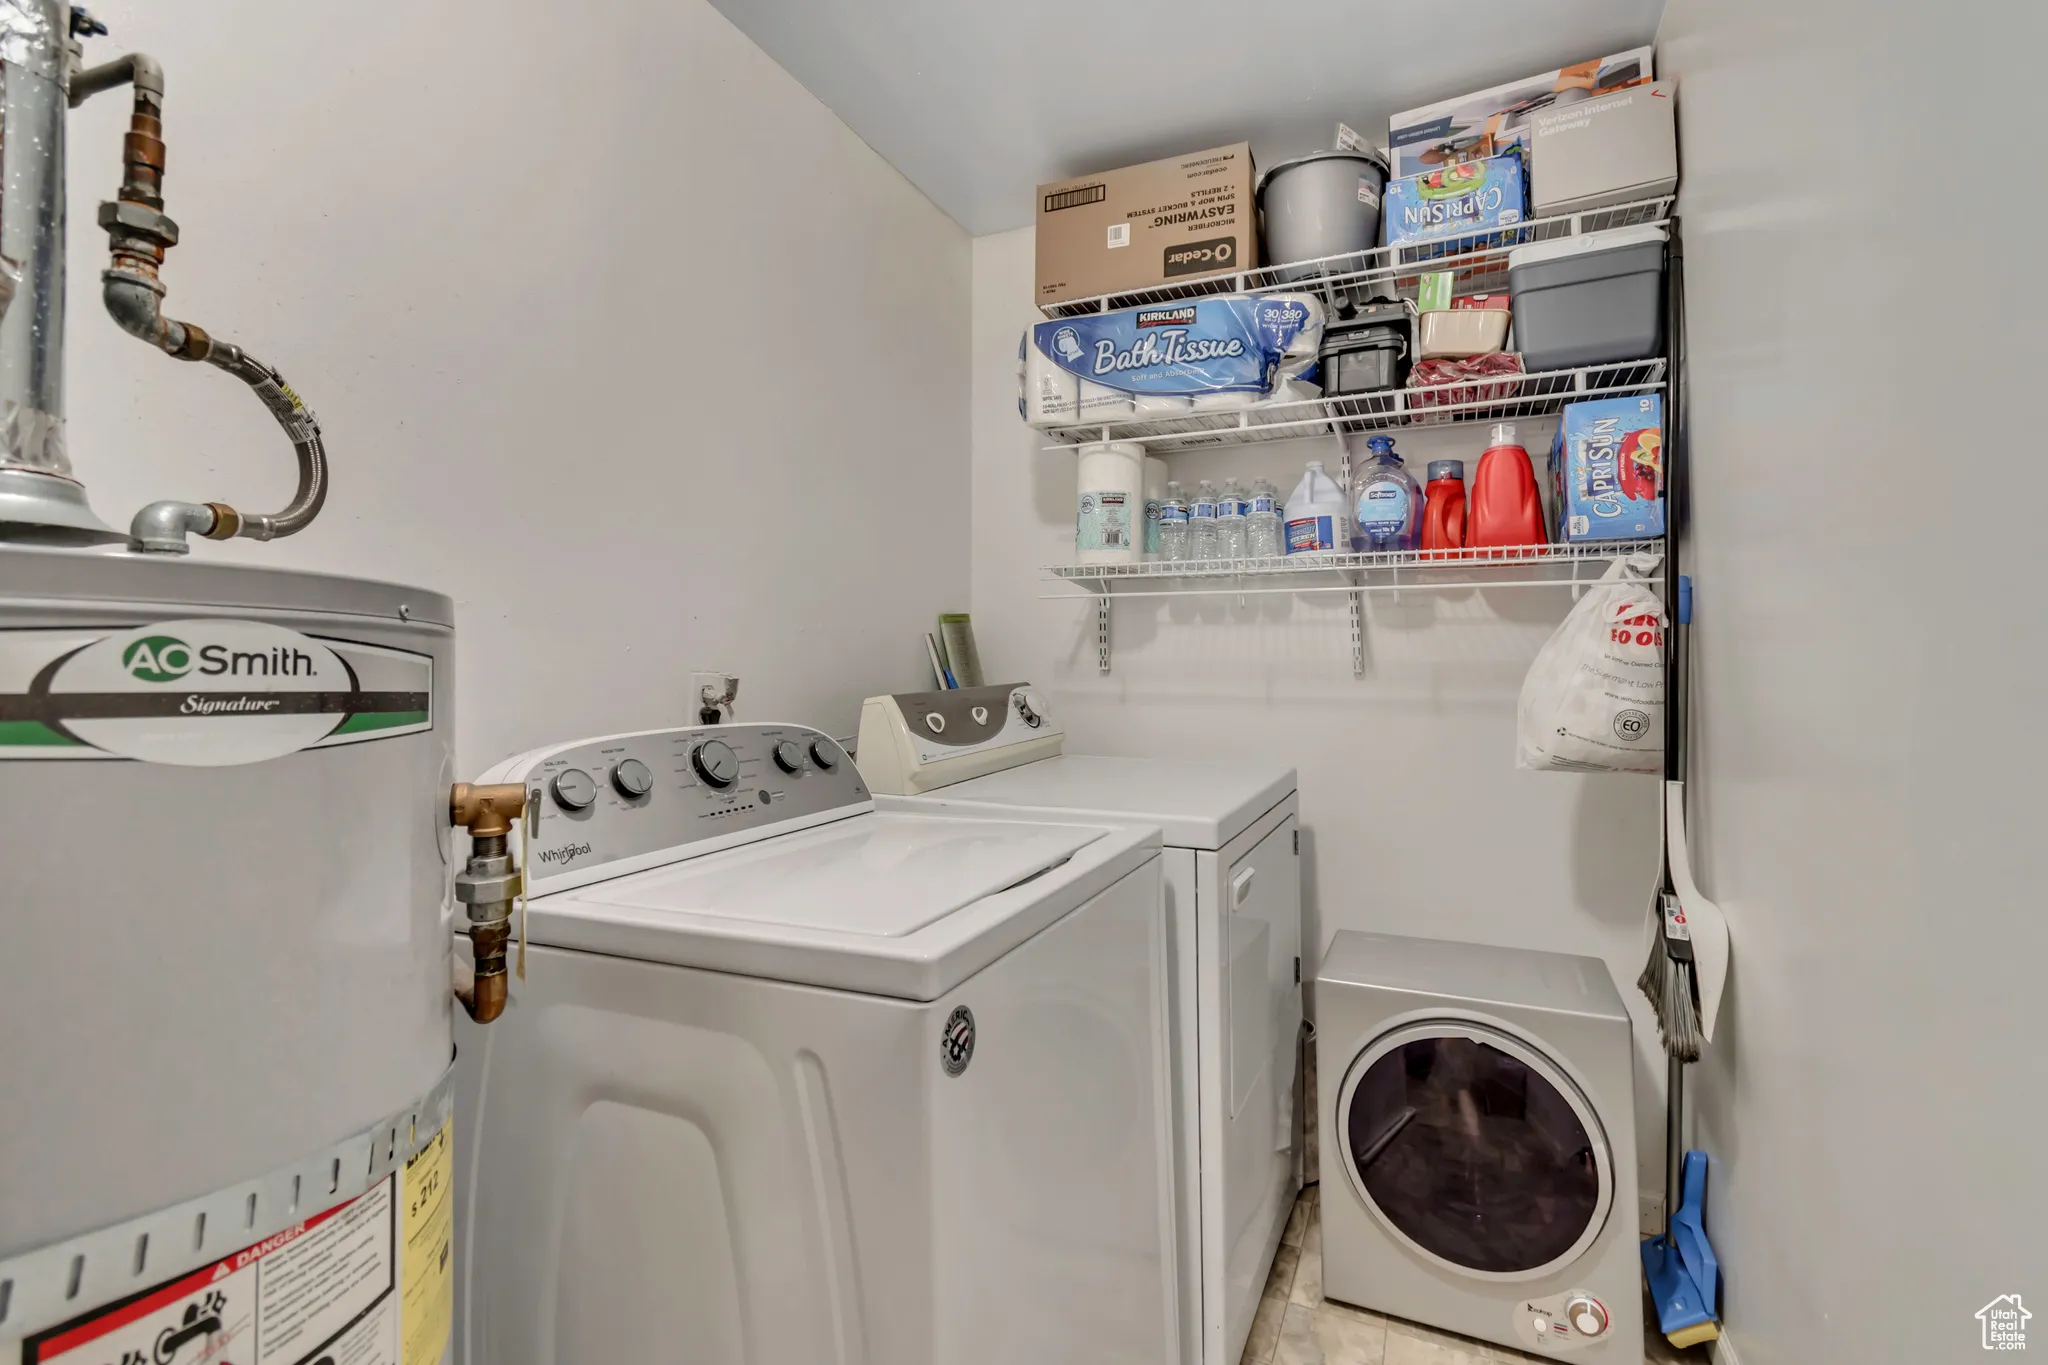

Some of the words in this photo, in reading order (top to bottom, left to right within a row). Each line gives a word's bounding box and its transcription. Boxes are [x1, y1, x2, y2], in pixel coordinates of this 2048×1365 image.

[1538, 107, 1582, 126] Verizon
[1584, 96, 1633, 116] Internet
[1539, 117, 1592, 138] Gateway
[1187, 166, 1227, 179] ocedar.com
[1191, 187, 1221, 198] REFILLS
[1223, 185, 1229, 193] 2
[1198, 197, 1216, 205] MOP
[1217, 192, 1235, 202] SPIN
[1126, 207, 1156, 219] SYSTEM
[1158, 202, 1188, 213] BUCKET
[1187, 218, 1235, 232] MICROFIBER
[1139, 308, 1195, 322] KIRKLAND
[1264, 309, 1279, 319] 30
[1281, 309, 1303, 320] 380
[1095, 333, 1163, 375] Bath
[1162, 330, 1244, 364] Tissue
[1132, 373, 1147, 382] Soft
[1149, 372, 1163, 380] and
[1640, 399, 1650, 413] 10
[1370, 491, 1396, 499] Softsoap
[126, 641, 196, 677] AO
[1623, 719, 1641, 732] EO
[538, 842, 592, 865] Whirlpool
[420, 1170, 438, 1208] 212
[236, 1220, 307, 1269] DANGER
